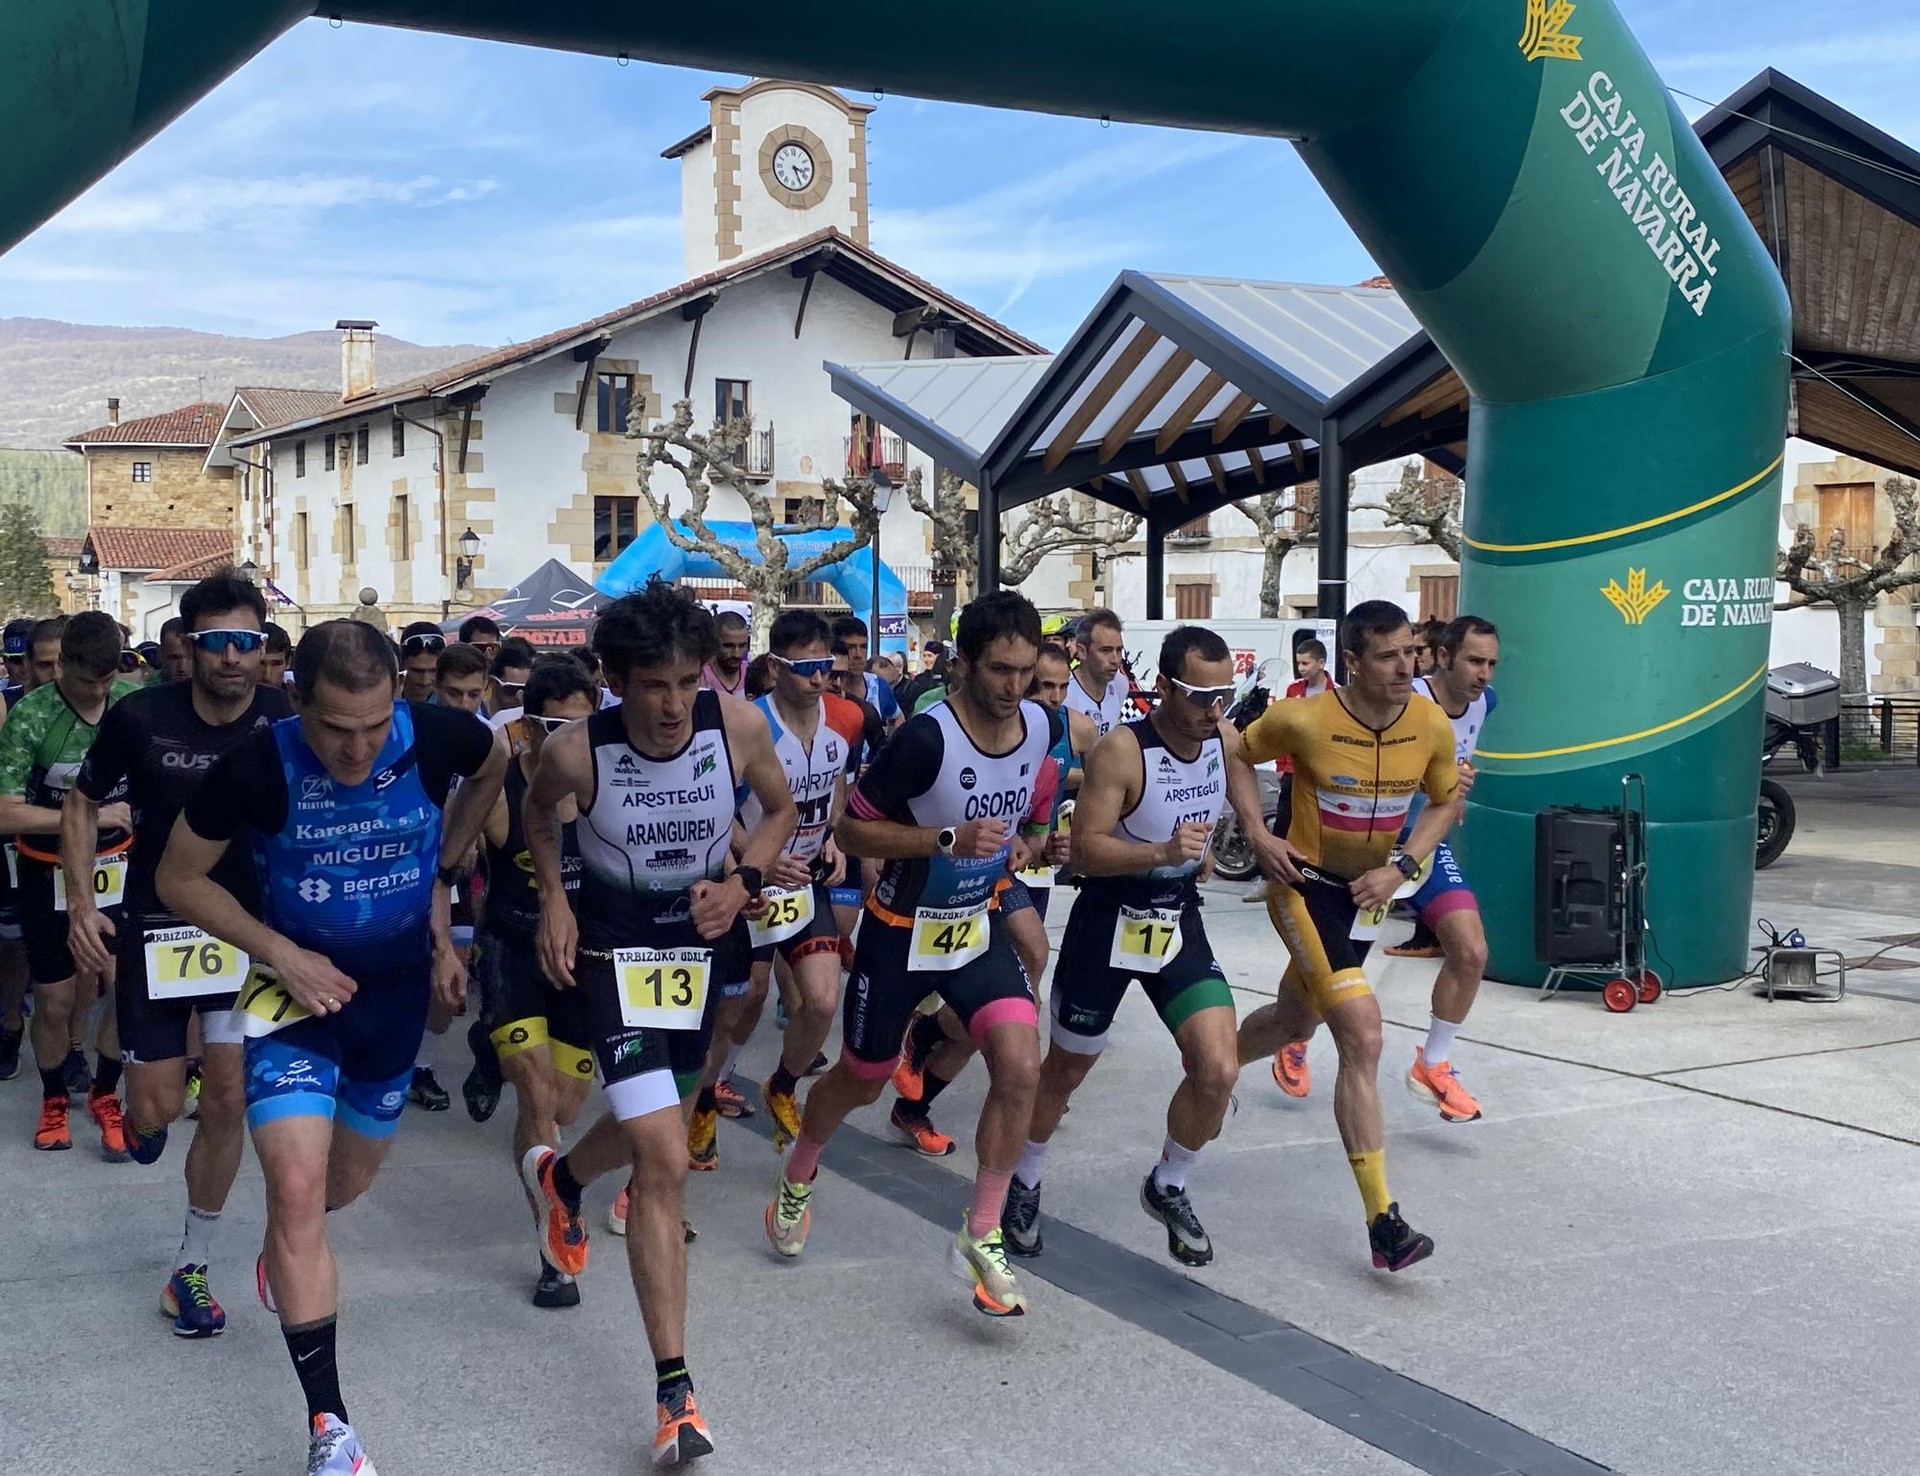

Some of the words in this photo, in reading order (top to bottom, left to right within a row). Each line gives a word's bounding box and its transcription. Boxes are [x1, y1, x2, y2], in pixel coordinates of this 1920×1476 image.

[1588, 70, 1646, 165] CAJA
[1641, 152, 1721, 277] RURAL
[1559, 90, 1609, 155] DE
[1596, 147, 1712, 317] NAVARRA
[1683, 578, 1740, 603] CAJA
[1681, 604, 1717, 626] DE
[965, 786, 1027, 821] OSORO
[626, 817, 715, 846] ARANGUREN
[313, 842, 413, 866] MIGUEL
[767, 897, 799, 929] 25
[932, 921, 972, 954] 42
[1139, 924, 1175, 956] 17
[172, 942, 223, 978] 76
[645, 968, 693, 1007] 13
